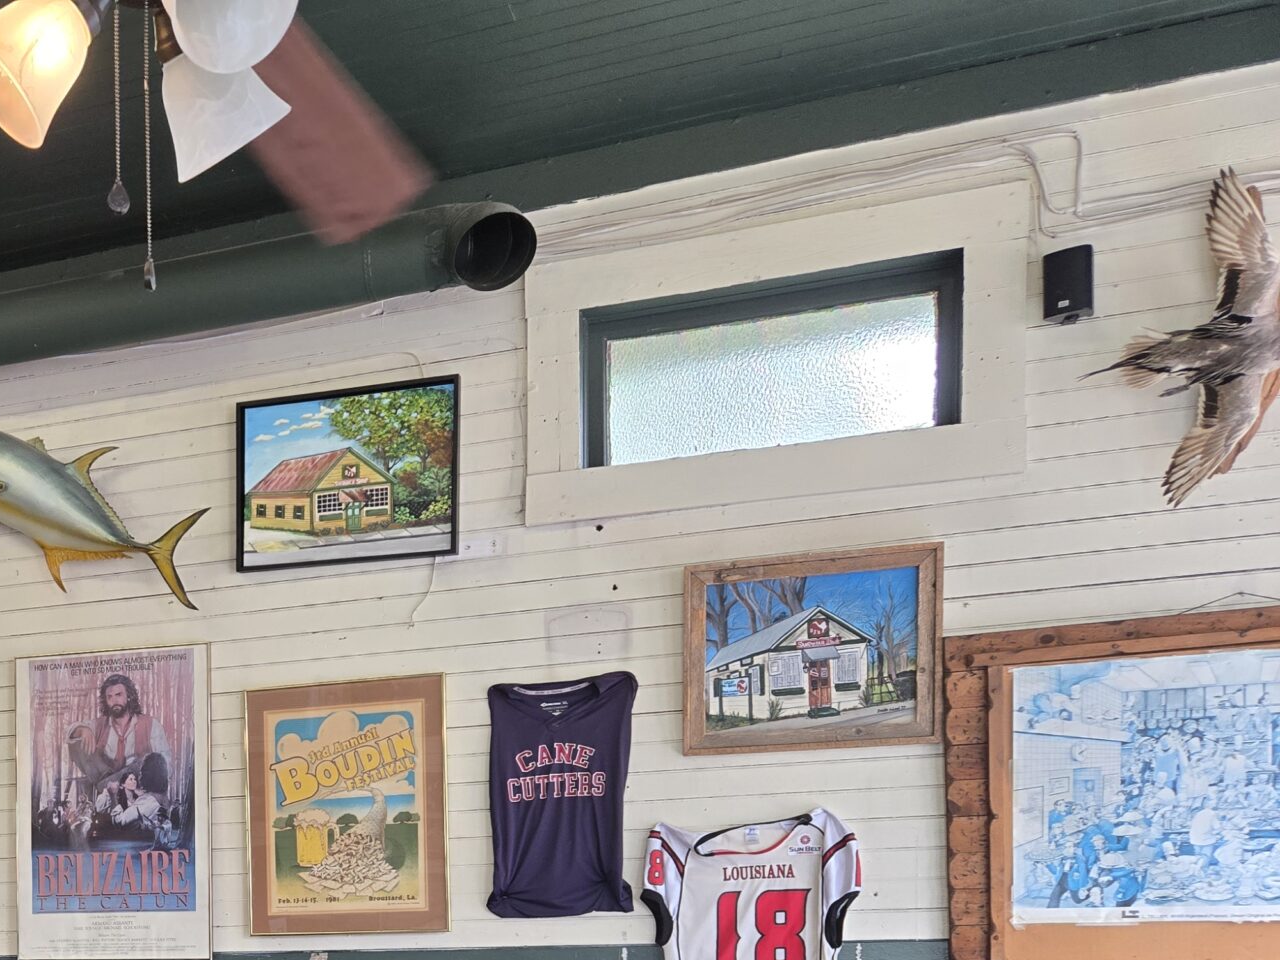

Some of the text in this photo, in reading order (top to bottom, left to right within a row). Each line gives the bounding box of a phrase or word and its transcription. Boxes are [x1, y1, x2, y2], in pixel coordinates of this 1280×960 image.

[34, 664, 48, 672] HOW
[50, 662, 62, 670] CAN
[69, 660, 83, 668] MAN
[85, 659, 99, 667] WHO
[100, 657, 122, 666] KNOWS
[124, 655, 149, 664] ALMOST
[150, 653, 187, 662] EVERYTHING
[71, 668, 81, 676] GET
[83, 667, 97, 675] INTO
[106, 664, 124, 672] MUCH
[308, 727, 379, 764] 3rd Annual
[516, 742, 596, 773] CANE
[270, 727, 415, 807] BOUDIN
[345, 757, 415, 791] FESTIVAL
[507, 772, 606, 803] CUTTERS
[36, 849, 191, 898] BELIZAIRE
[723, 864, 796, 881] LOUISIANA
[36, 894, 189, 911] THE CAJUN
